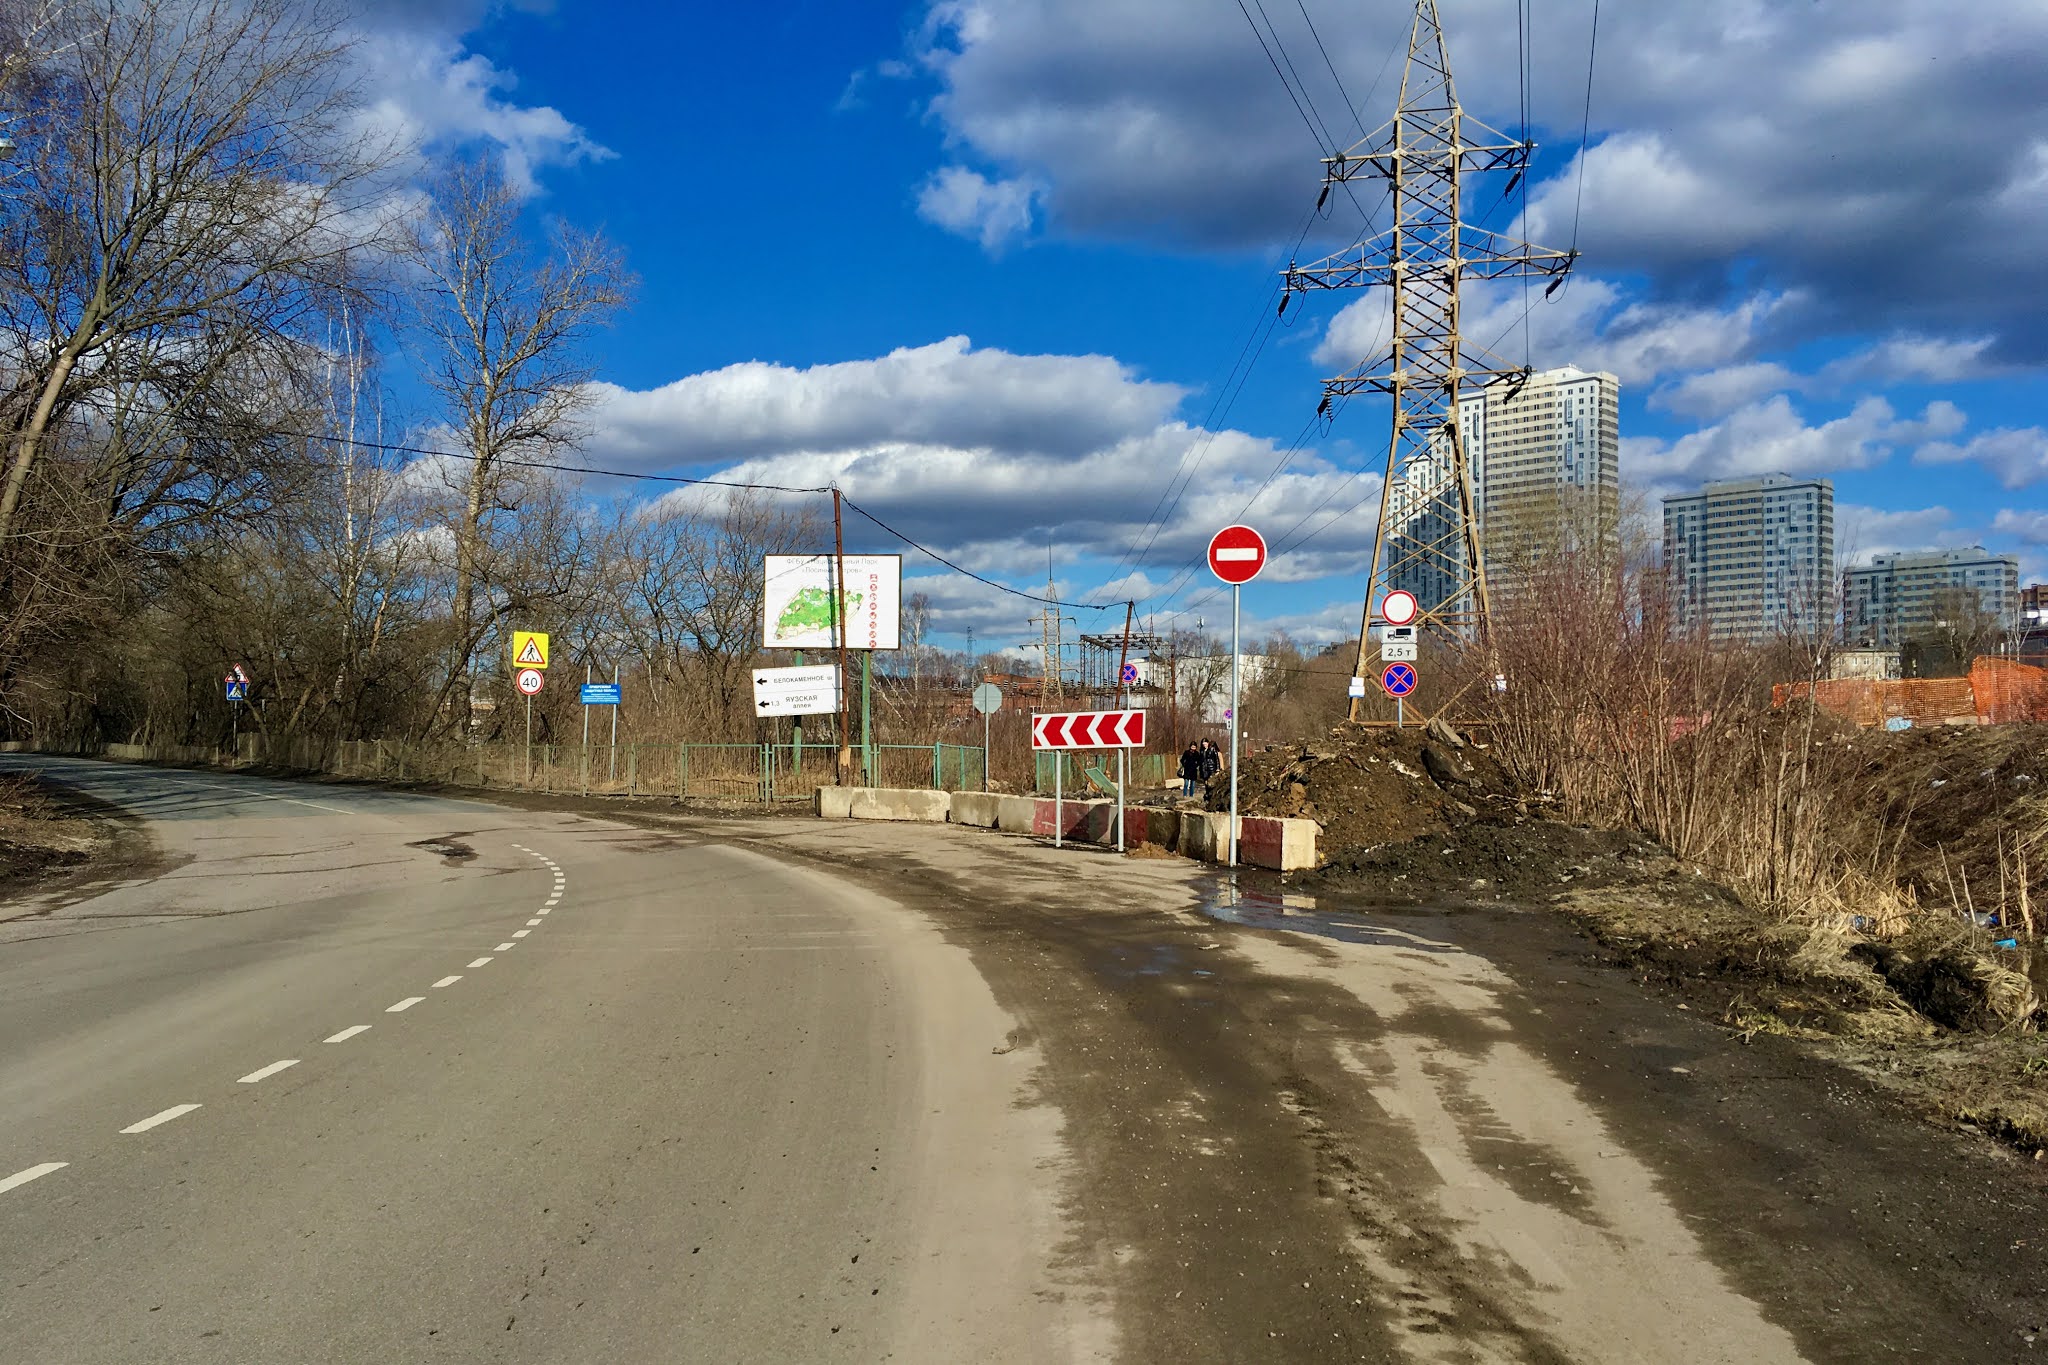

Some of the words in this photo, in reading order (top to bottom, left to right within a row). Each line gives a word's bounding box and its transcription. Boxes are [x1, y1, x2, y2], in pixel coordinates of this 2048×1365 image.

[1387, 647, 1403, 658] 2,5
[522, 677, 538, 688] 40
[773, 675, 825, 684] БЕЛОКАМЕННОЕ
[785, 694, 818, 703] ЯУЗСКАЯ
